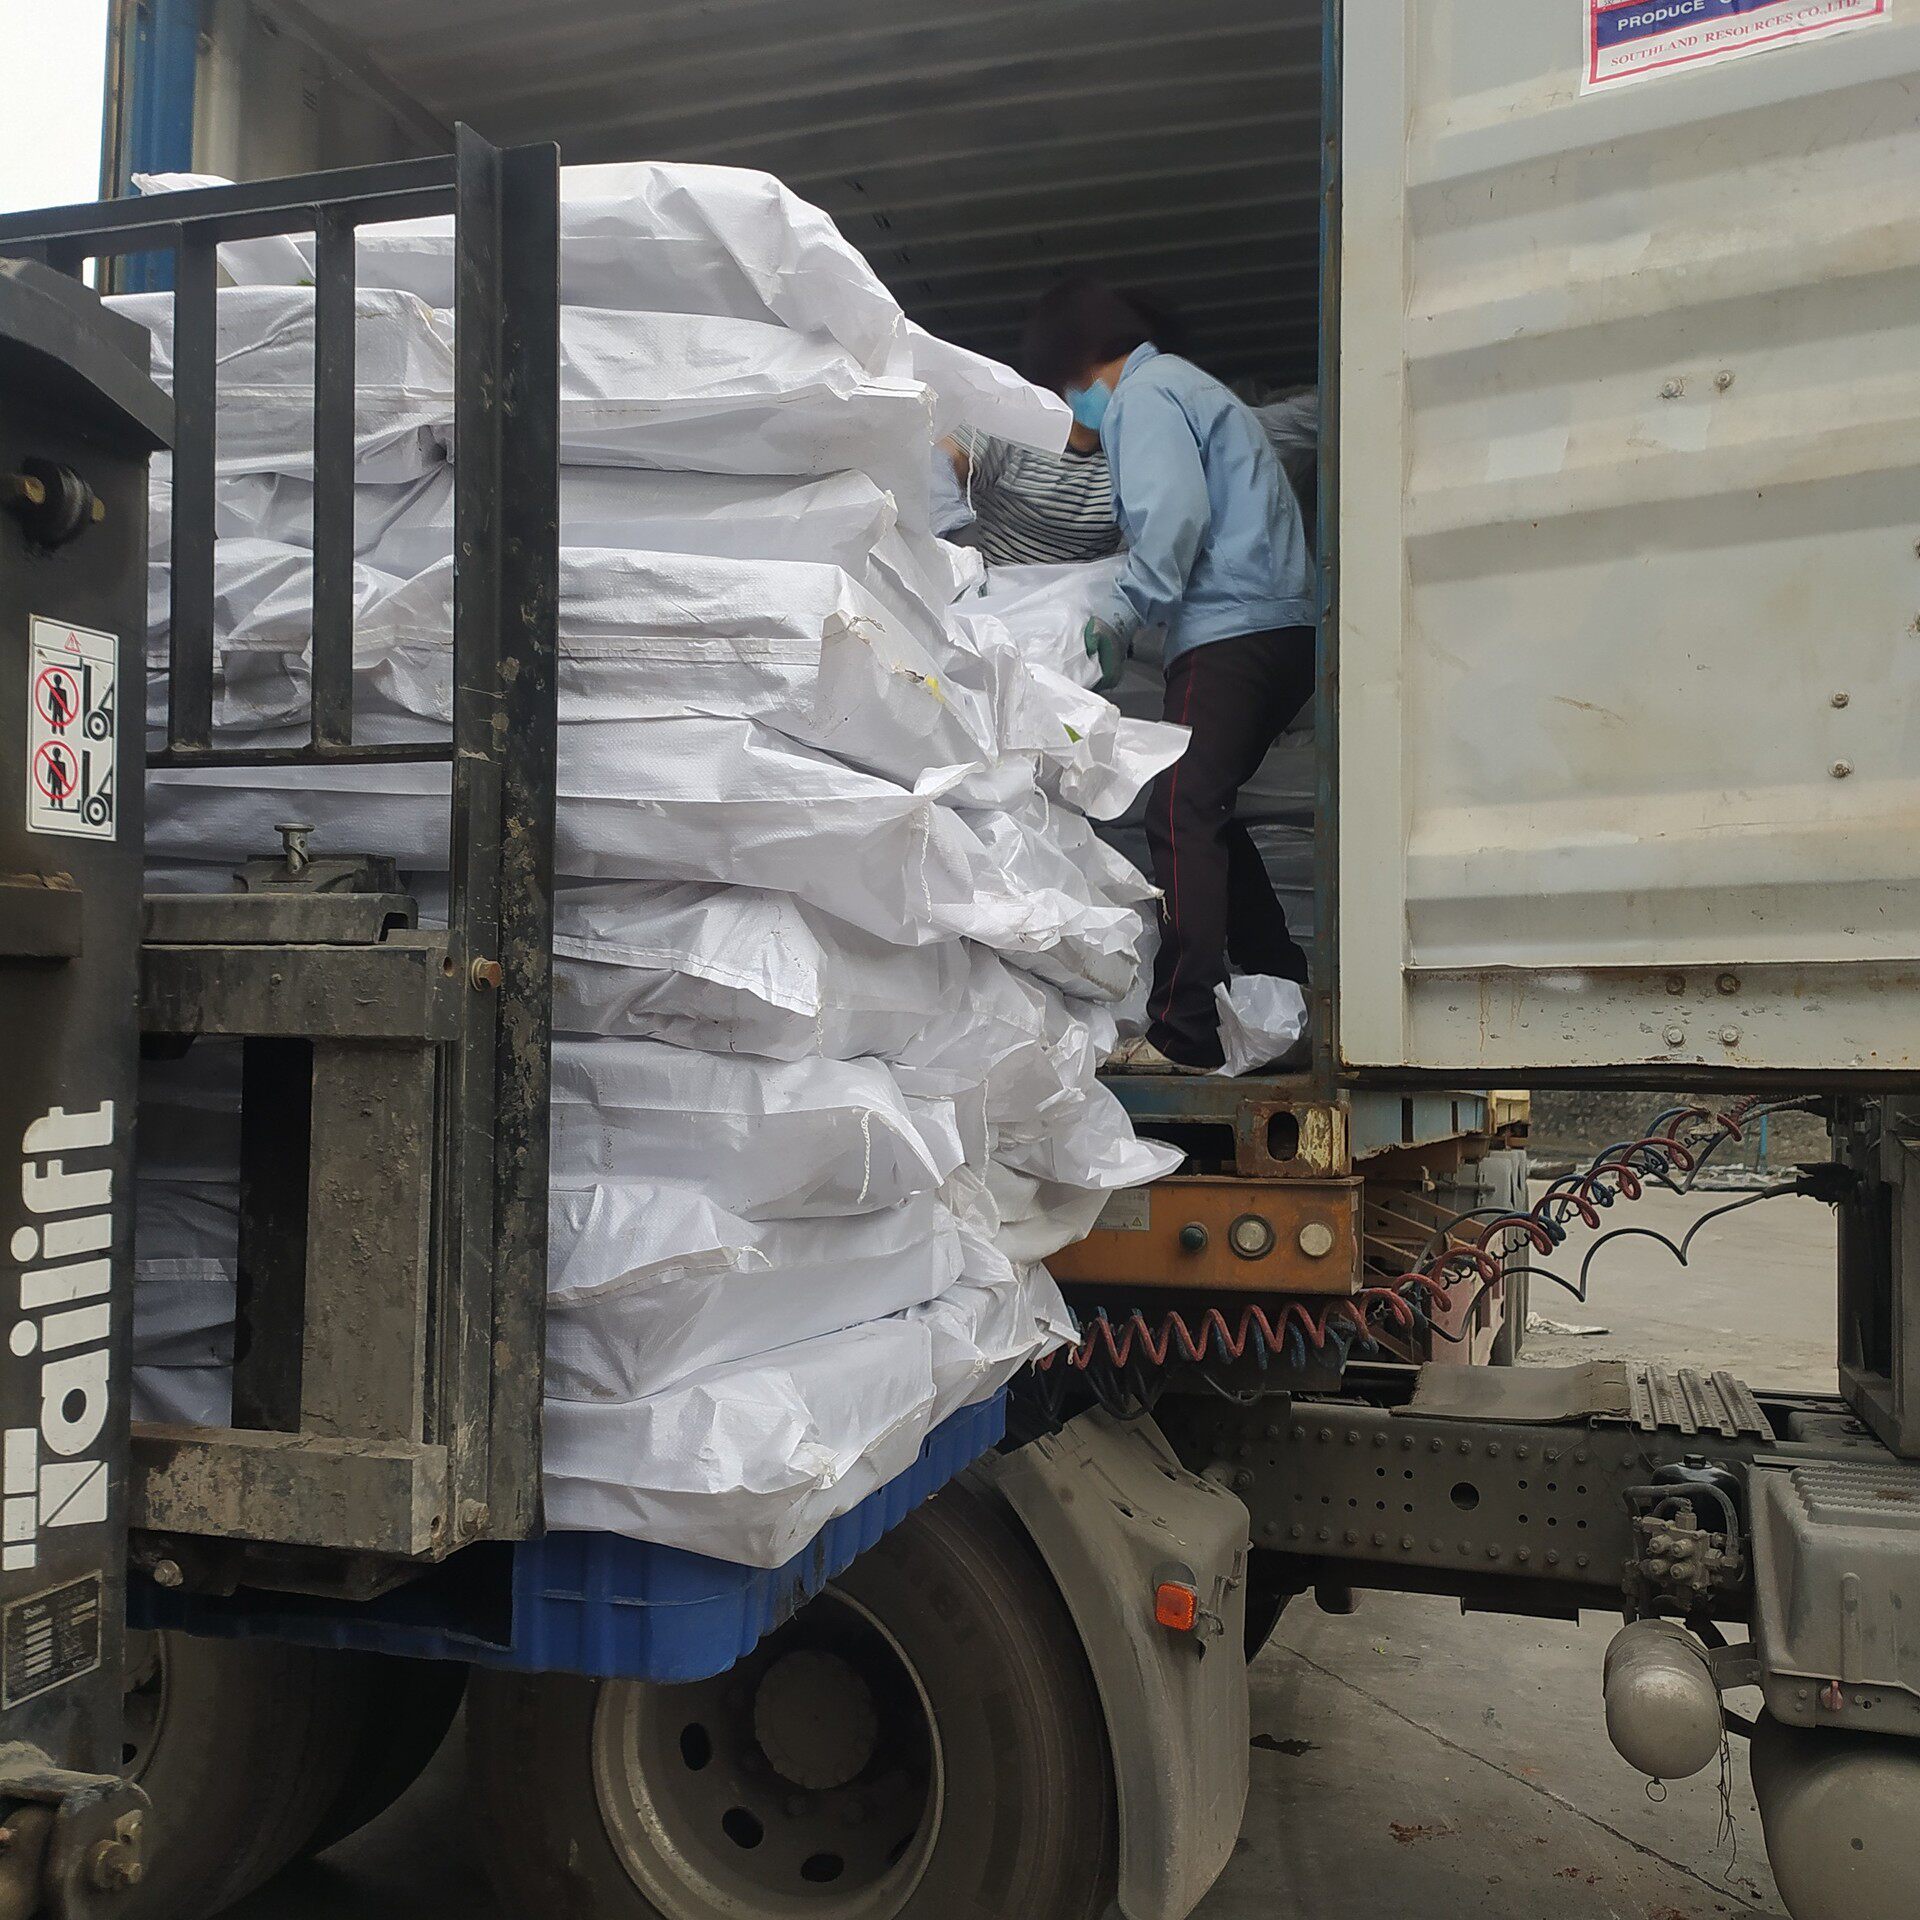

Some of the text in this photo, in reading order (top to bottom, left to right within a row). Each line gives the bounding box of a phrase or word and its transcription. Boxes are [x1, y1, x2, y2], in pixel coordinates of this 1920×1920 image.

[1617, 0, 1705, 31] PRODUCE
[1705, 14, 1794, 42] RESOURCES
[3, 1100, 113, 1571] Tailift
